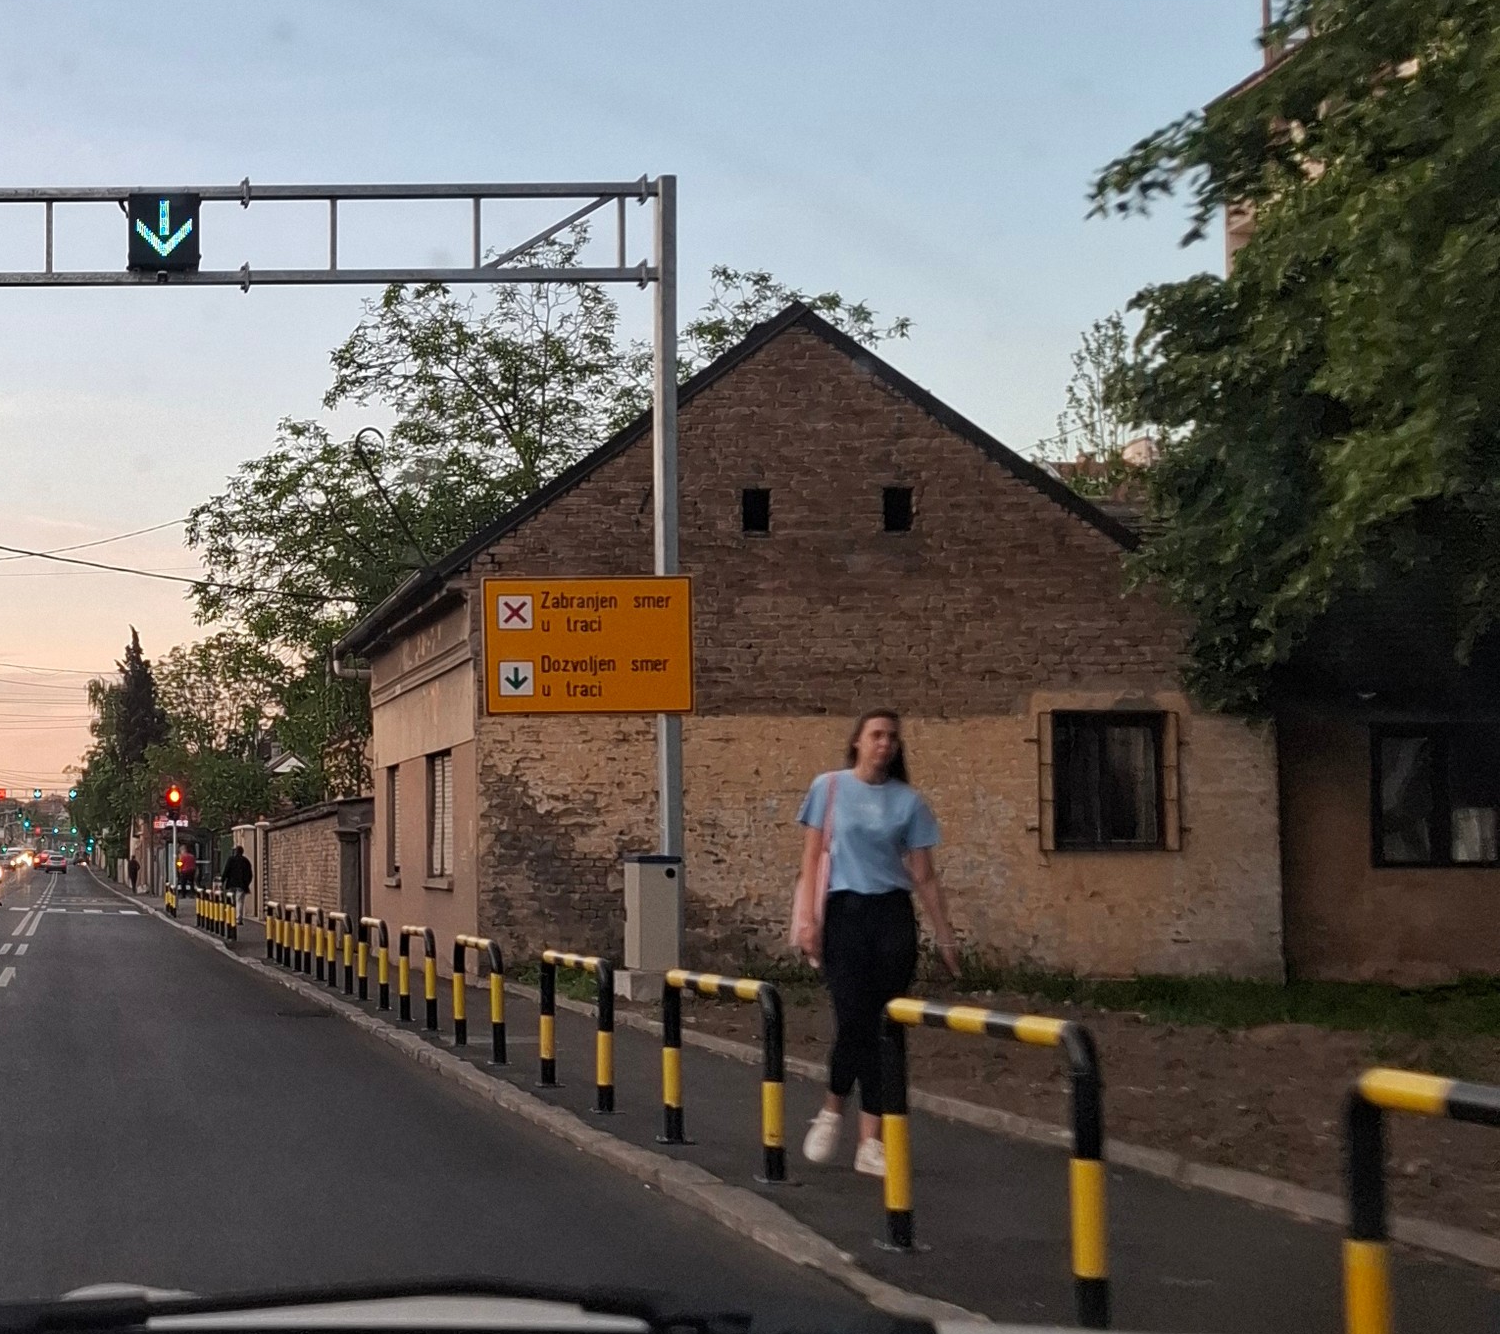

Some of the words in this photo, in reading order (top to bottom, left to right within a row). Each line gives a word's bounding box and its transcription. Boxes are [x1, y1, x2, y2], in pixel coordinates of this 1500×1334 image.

[540, 590, 618, 612] Zabranjen
[633, 594, 672, 609] smer
[541, 619, 551, 633] u
[566, 615, 603, 633] traci
[540, 654, 617, 676] Dozvoljen
[630, 657, 669, 673] smer
[541, 684, 552, 698] u
[565, 680, 603, 698] traci
